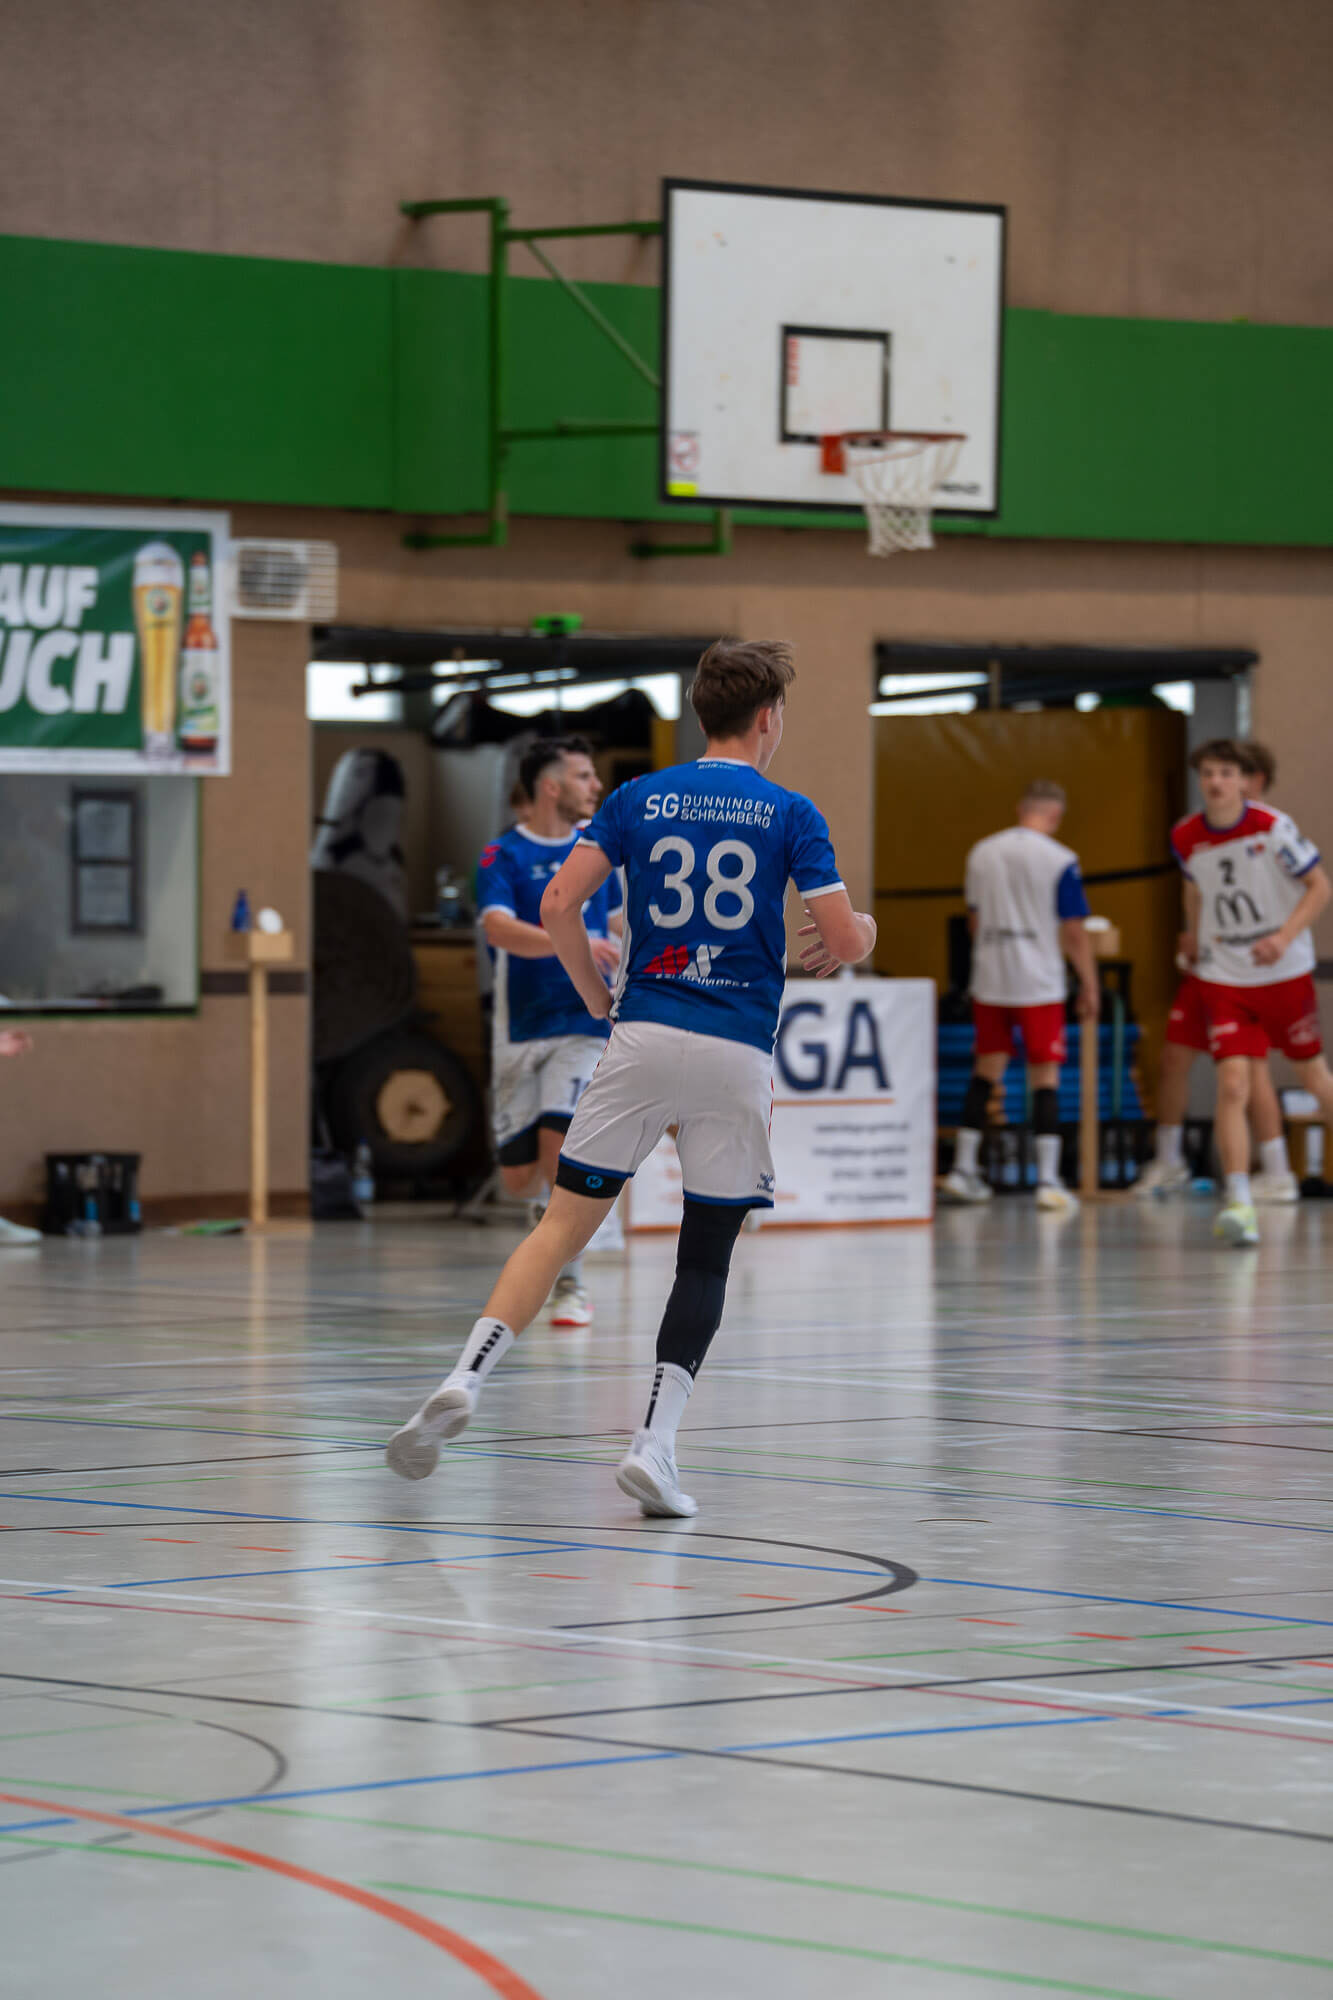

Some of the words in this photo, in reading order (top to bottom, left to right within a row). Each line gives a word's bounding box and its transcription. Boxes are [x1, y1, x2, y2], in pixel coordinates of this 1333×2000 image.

[644, 793, 679, 820] SG
[680, 807, 771, 829] SCHRAMBERG
[683, 794, 775, 817] DUNNINGEN
[649, 836, 757, 930] 38
[1218, 858, 1235, 885] 2
[777, 998, 892, 1091] GA
[570, 1078, 592, 1106] 1
